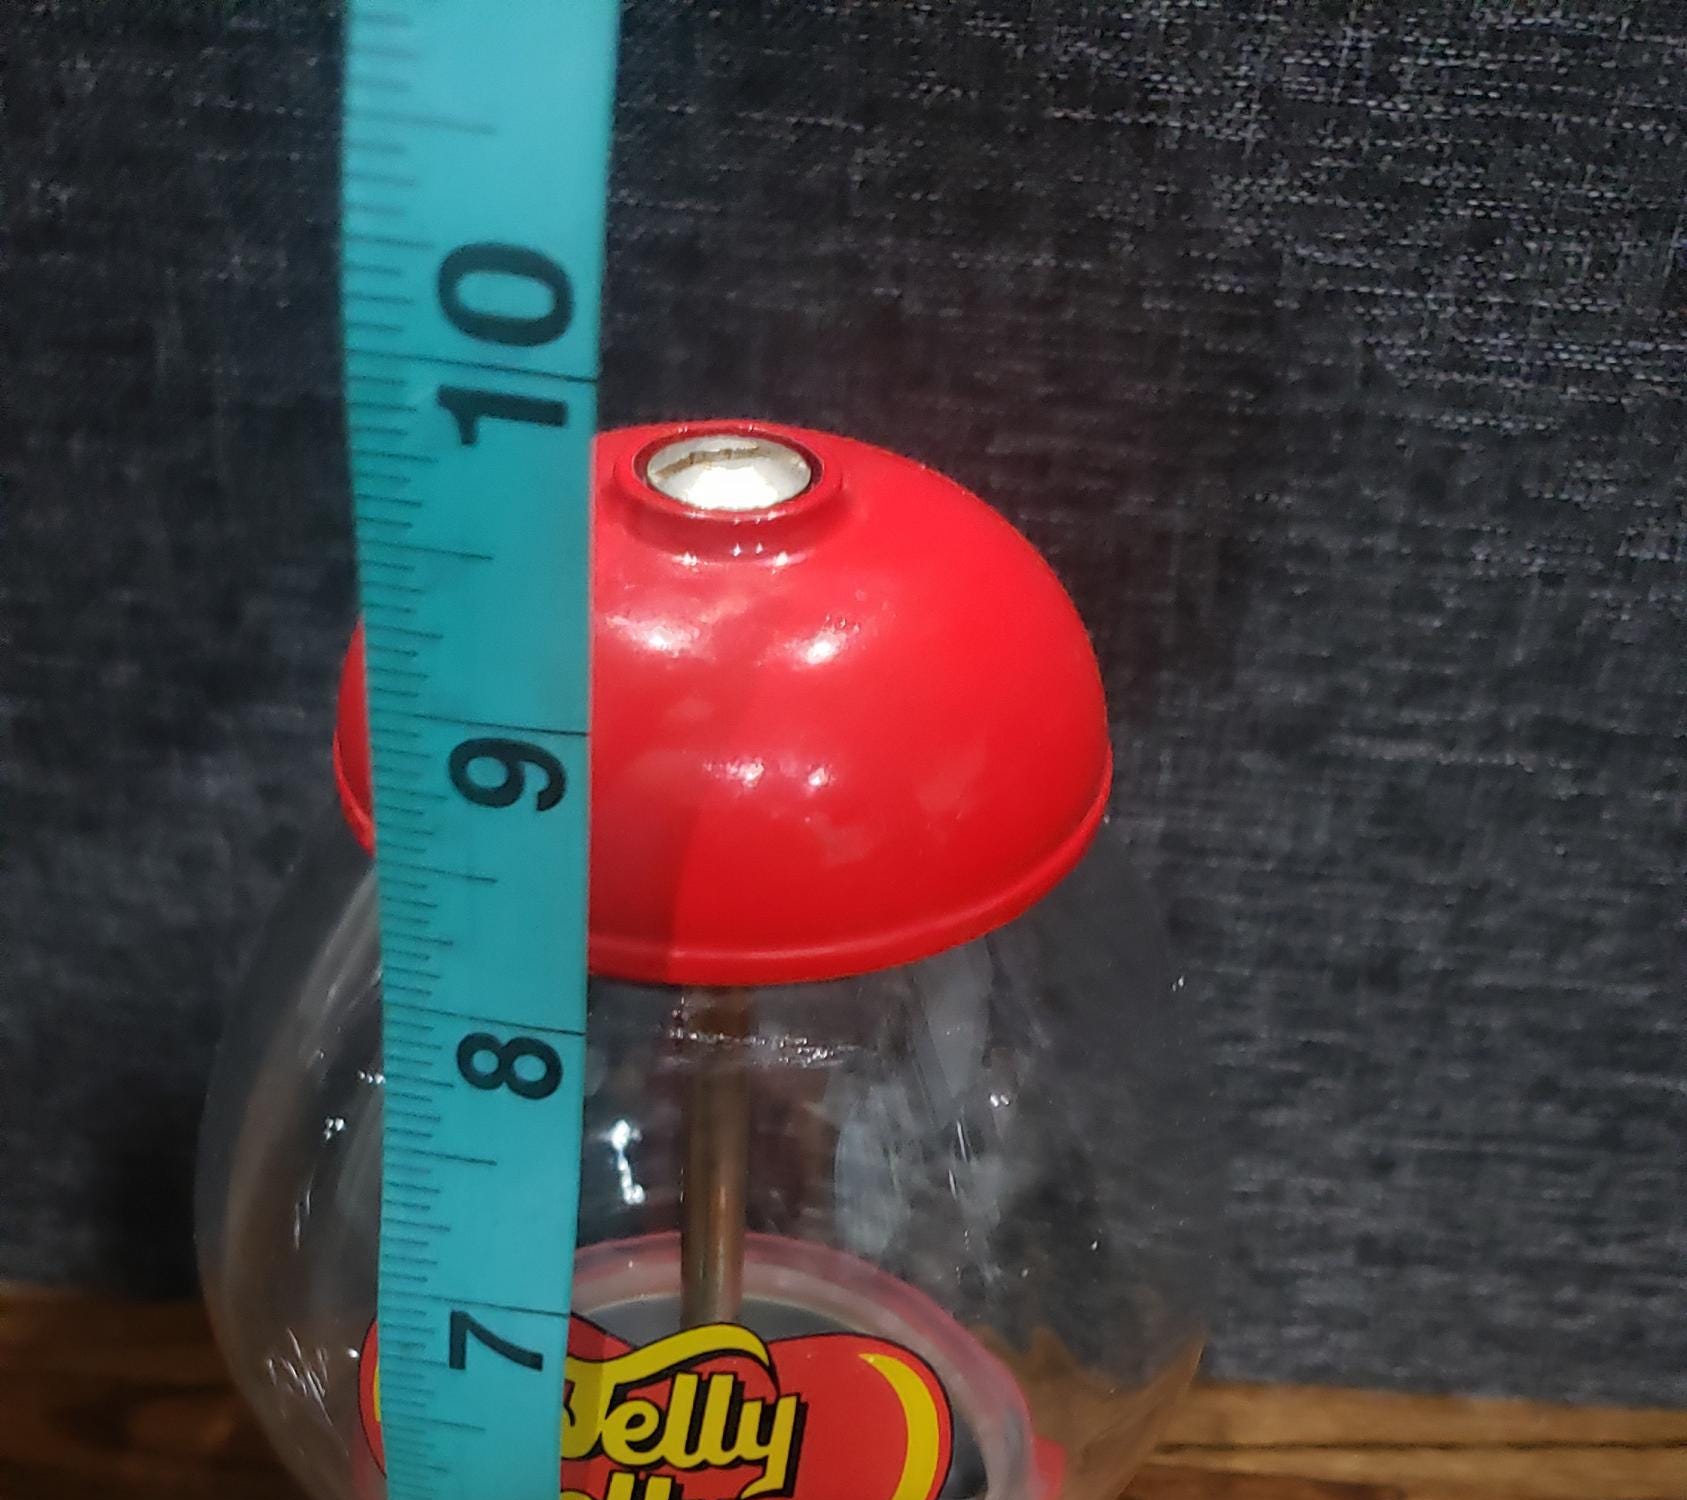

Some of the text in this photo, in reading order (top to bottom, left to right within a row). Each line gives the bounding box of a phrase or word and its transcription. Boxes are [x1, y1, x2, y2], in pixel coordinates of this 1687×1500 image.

[436, 242, 573, 446] 10
[448, 737, 567, 813] 9
[456, 1032, 562, 1100] 8
[449, 1310, 543, 1371] 7
[562, 1324, 808, 1500] Jelly
